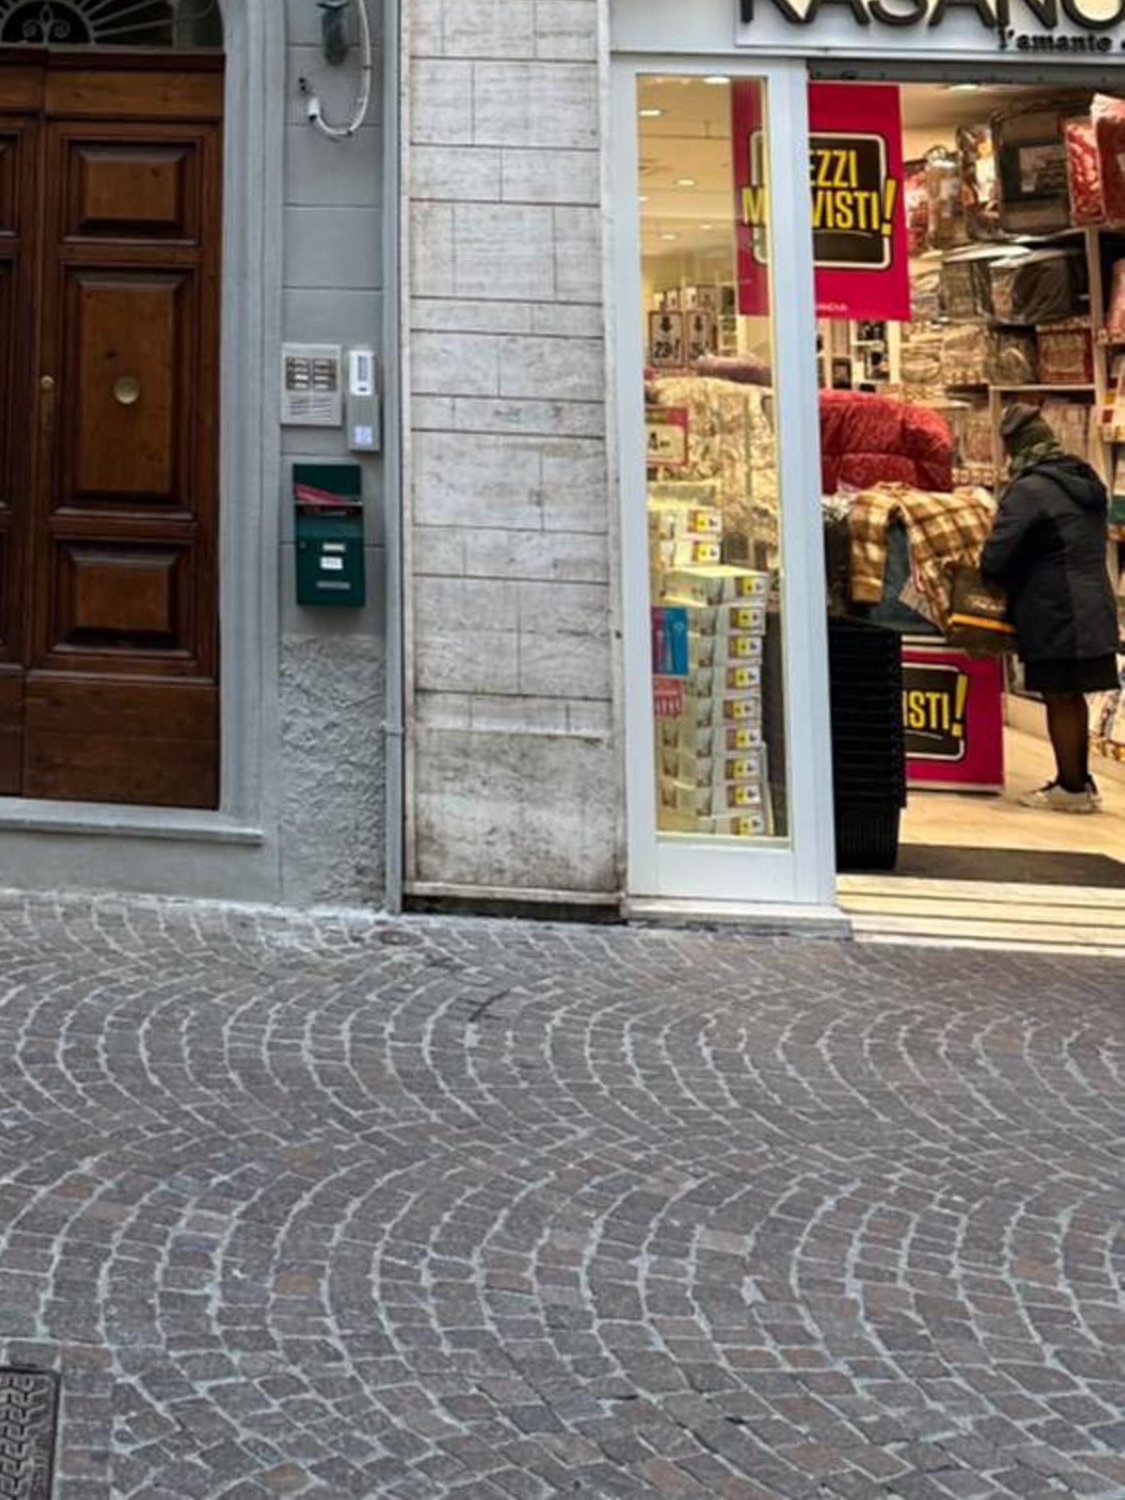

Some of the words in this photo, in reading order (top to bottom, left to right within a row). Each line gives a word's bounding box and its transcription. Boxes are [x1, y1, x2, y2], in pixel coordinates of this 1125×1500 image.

[998, 28, 1113, 52] l'amante
[808, 148, 859, 188] EZZI
[902, 674, 968, 737] ISTI!
